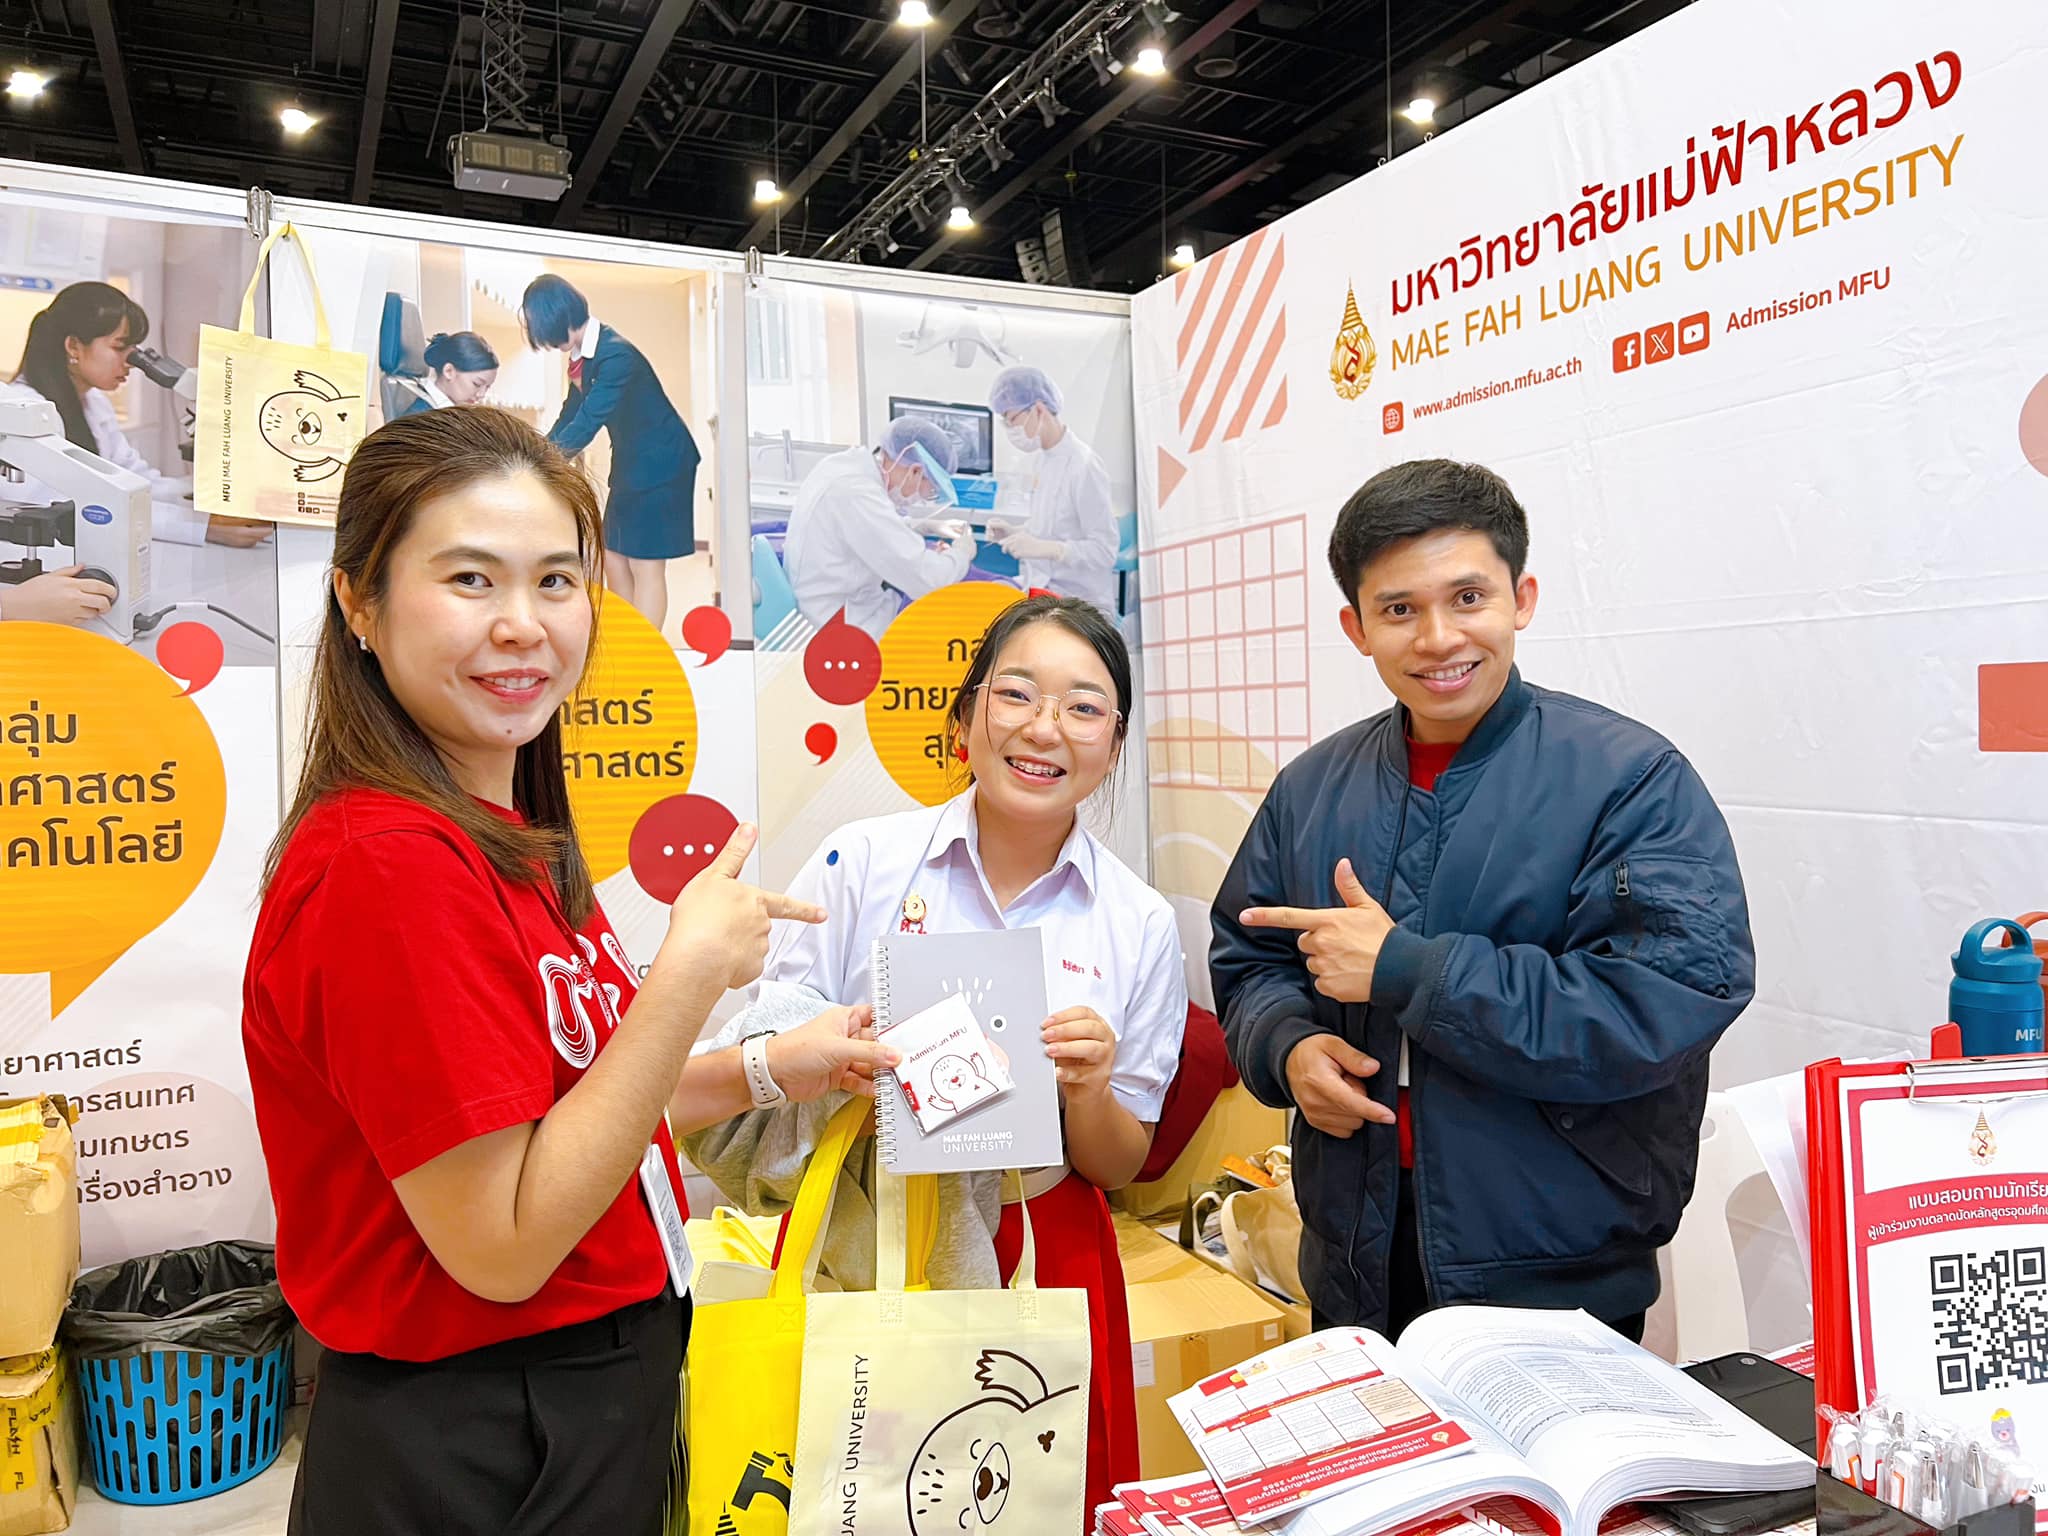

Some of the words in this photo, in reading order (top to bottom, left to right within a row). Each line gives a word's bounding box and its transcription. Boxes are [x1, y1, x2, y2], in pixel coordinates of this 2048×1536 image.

[1390, 49, 1964, 316] มหาวิทยาลัยแม่ฟ้าหลวง
[1391, 320, 1450, 371] MAE
[1464, 294, 1522, 347] FAH
[1540, 245, 1660, 322] LUANG
[1683, 133, 1966, 272] UNIVERSITY
[1725, 287, 1832, 335] Admission
[1838, 266, 1892, 306] MFU
[224, 355, 233, 405] UNIVERSITY
[1412, 356, 1583, 419] www.admission.mfu.ac.th
[223, 409, 232, 441] LUANG
[561, 688, 654, 725] าสตร์
[0, 700, 77, 758] ลุ่ม
[563, 740, 686, 780] ศาสตร์
[0, 761, 177, 806] ศาสตร์
[0, 815, 183, 868] คโนโลยี
[948, 1026, 968, 1041] MFU
[2015, 1028, 2043, 1042] MFU
[0, 1038, 143, 1076] ยาศาสตร์
[68, 1083, 196, 1114] ารสนเทศ
[76, 1129, 190, 1158] มเกษตร
[942, 1133, 962, 1144] MAE
[963, 1132, 981, 1142] FAH
[982, 1130, 1013, 1141] LUANG
[943, 1140, 1014, 1154] UNIVERSITY
[845, 1354, 869, 1471] UNIVERSITY
